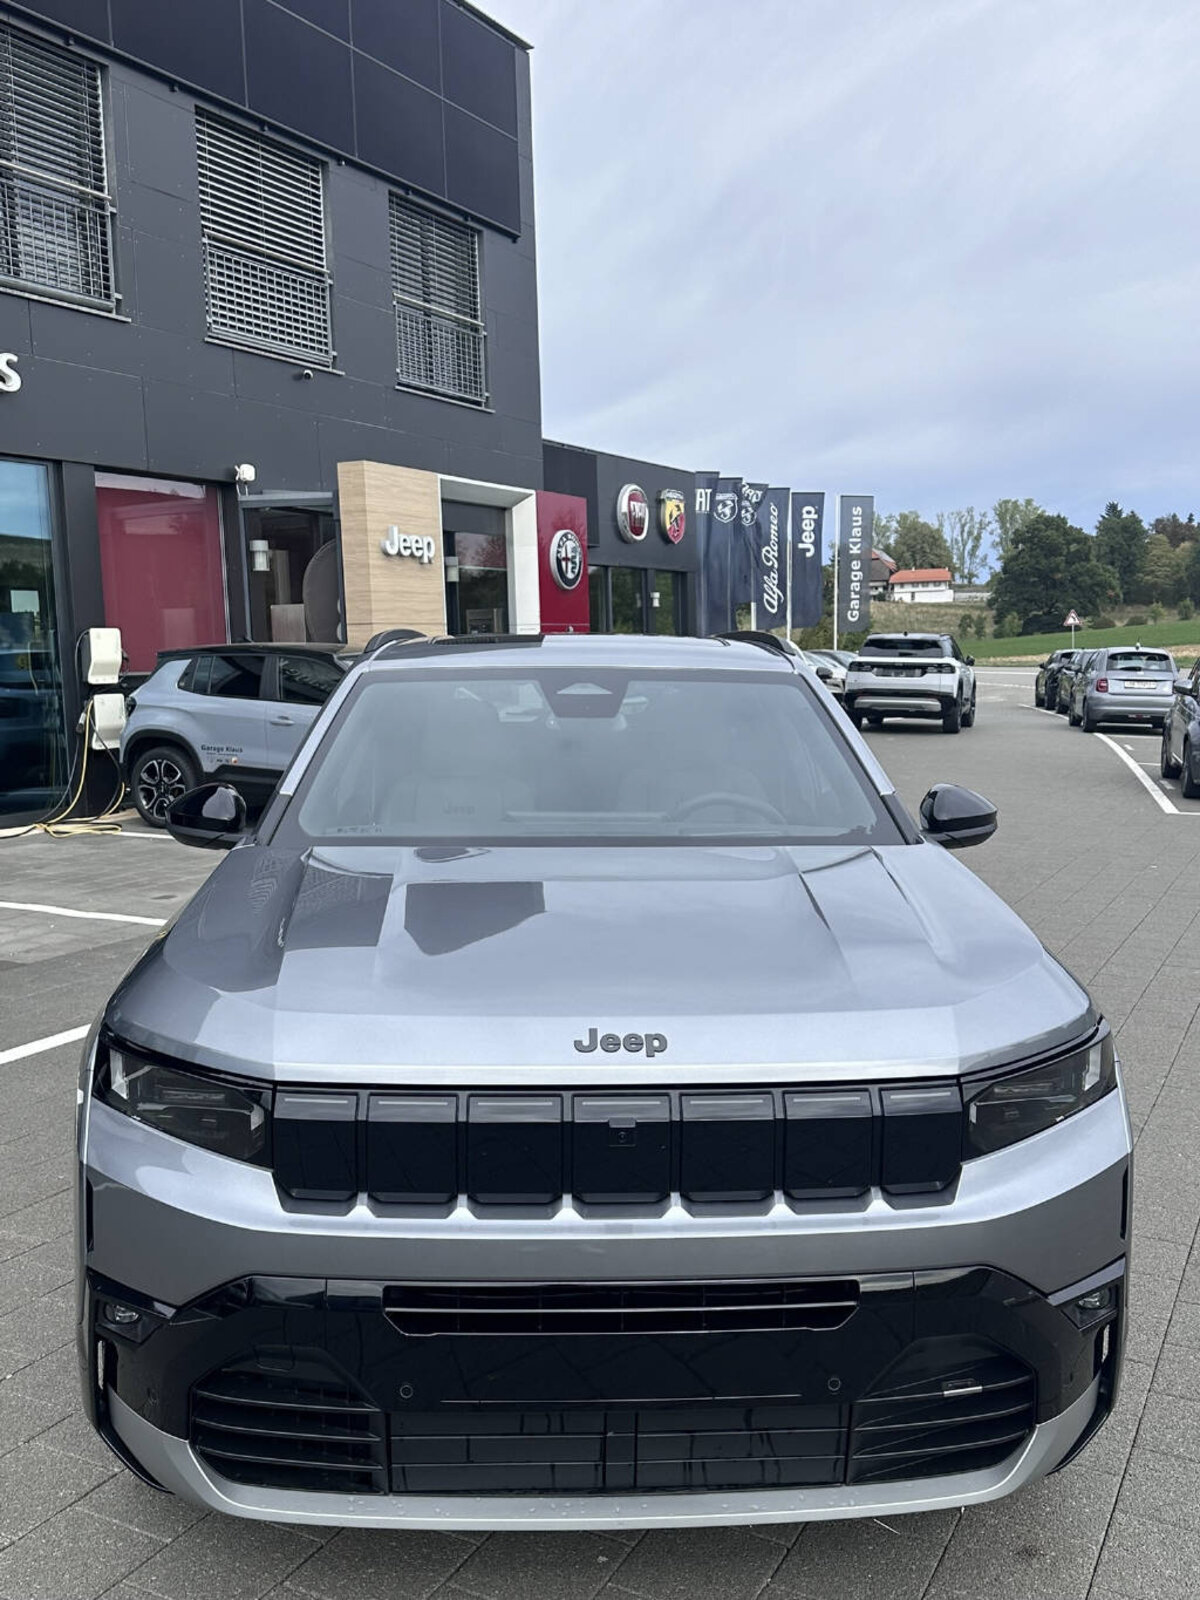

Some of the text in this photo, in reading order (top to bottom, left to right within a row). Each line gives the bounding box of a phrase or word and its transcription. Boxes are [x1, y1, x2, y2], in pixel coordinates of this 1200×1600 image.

[382, 525, 436, 563] Jeep
[762, 502, 784, 614] Alfa Romeo
[798, 505, 818, 558] Jeep
[847, 506, 863, 622] Garage Klaus
[574, 1028, 668, 1057] Jeep
